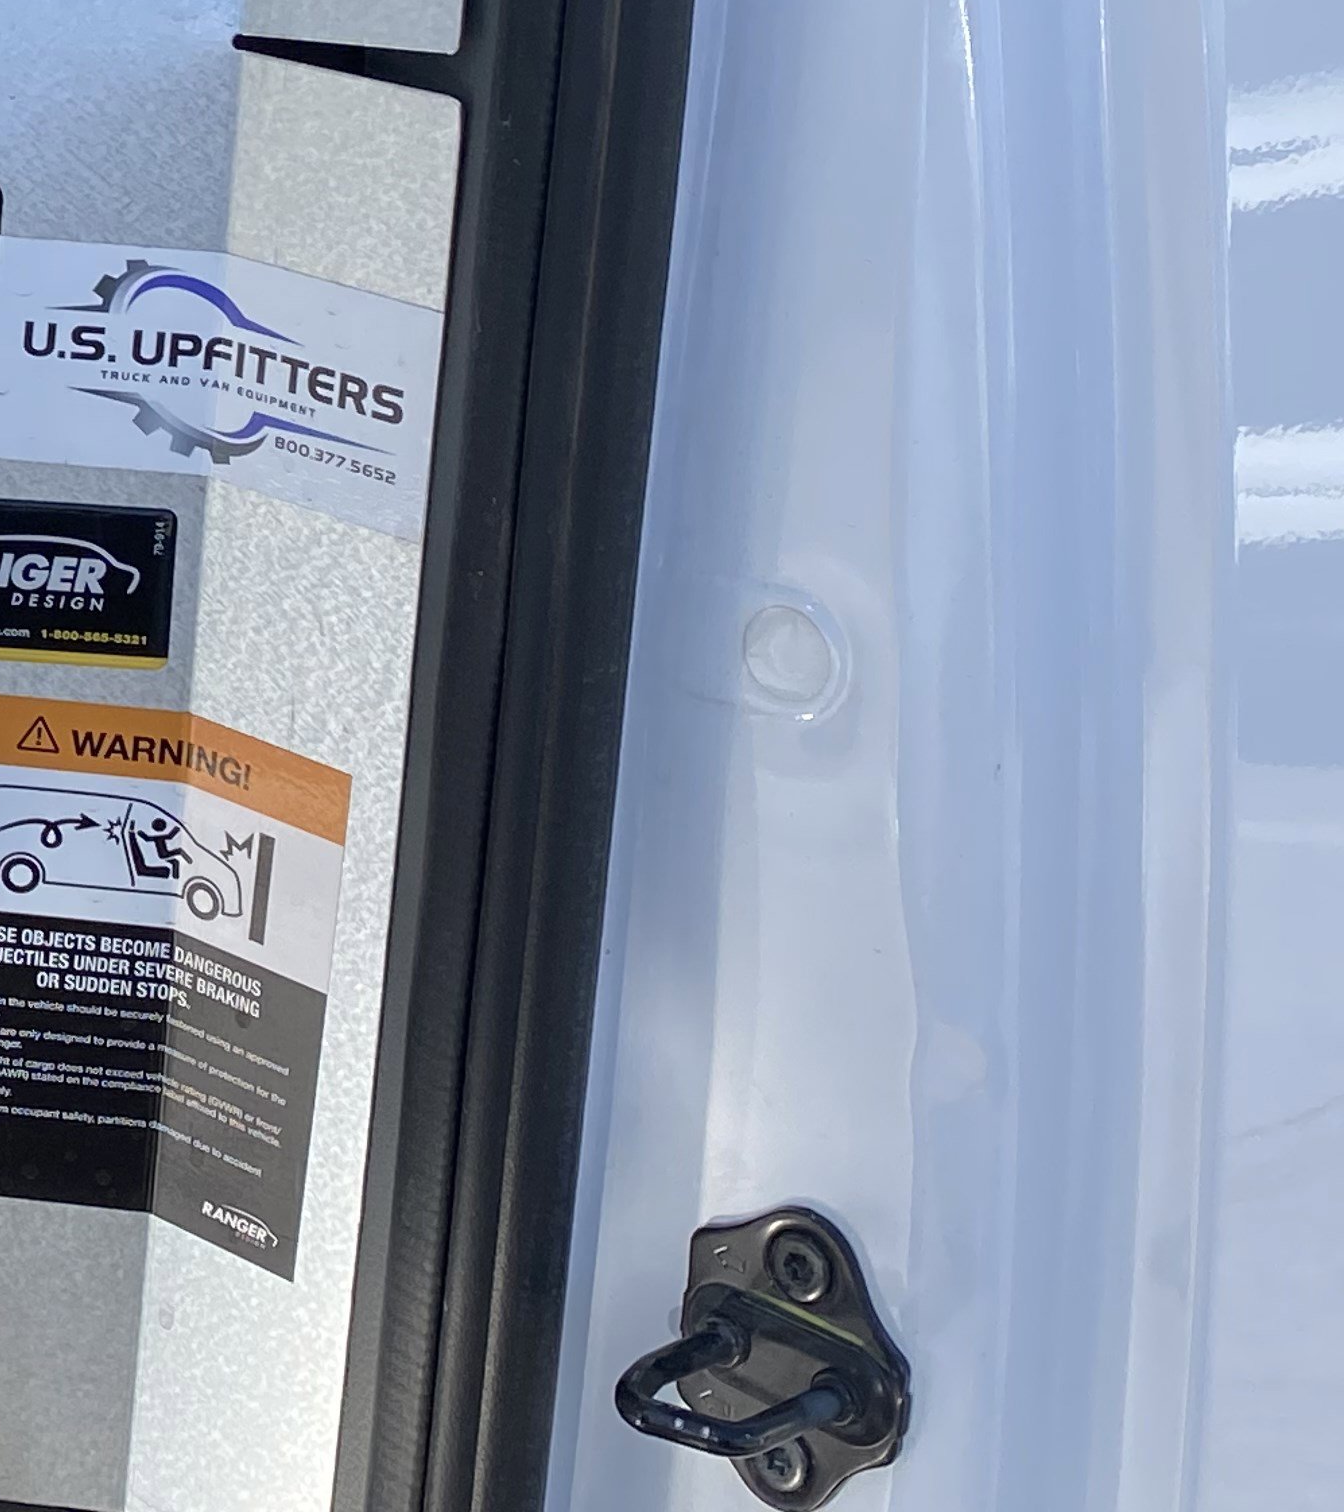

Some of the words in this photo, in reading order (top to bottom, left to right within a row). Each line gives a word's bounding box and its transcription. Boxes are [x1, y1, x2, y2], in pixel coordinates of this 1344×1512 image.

[23, 321, 116, 363] U.S.
[132, 330, 404, 425] UPFITTERS
[101, 370, 151, 383] TRUCK
[159, 375, 191, 386] AND
[200, 378, 230, 392] VAN
[237, 386, 316, 419] EQUIPMENT
[274, 436, 397, 486] 800.377.5652
[11, 592, 104, 611] DESIGN
[71, 729, 252, 791] WARNING!
[21, 928, 96, 951] OBJECTS
[100, 936, 171, 959] BECOME
[173, 945, 262, 997] DANGEROUS
[73, 955, 130, 976] UNDER
[134, 960, 194, 989] SEVERE
[196, 977, 260, 1018] BRAKING
[36, 971, 60, 989] OR
[64, 974, 132, 997] SUDDEN
[136, 981, 191, 1010] STOPS.
[0, 1028, 17, 1036] are
[18, 1029, 41, 1041] only
[43, 1031, 91, 1044] designed
[93, 1036, 105, 1045] to
[106, 1038, 146, 1049] provide
[8, 997, 25, 1007] the
[27, 1000, 64, 1011] vehicle
[66, 1004, 102, 1015] should
[104, 1007, 118, 1016] be
[120, 1010, 164, 1023] securely
[245, 1051, 289, 1076] approved
[12, 1058, 23, 1067] of
[25, 1060, 55, 1071] cargo
[57, 1063, 84, 1073] does
[85, 1067, 103, 1075] not
[105, 1069, 143, 1080] exceed
[31, 1072, 64, 1083] stated
[66, 1076, 80, 1085] on
[82, 1076, 99, 1087] the
[11, 1107, 60, 1118] occupant
[97, 1115, 147, 1128] partitions
[193, 1139, 210, 1153] due
[212, 1147, 221, 1158] to
[202, 1201, 267, 1243] RANGER
